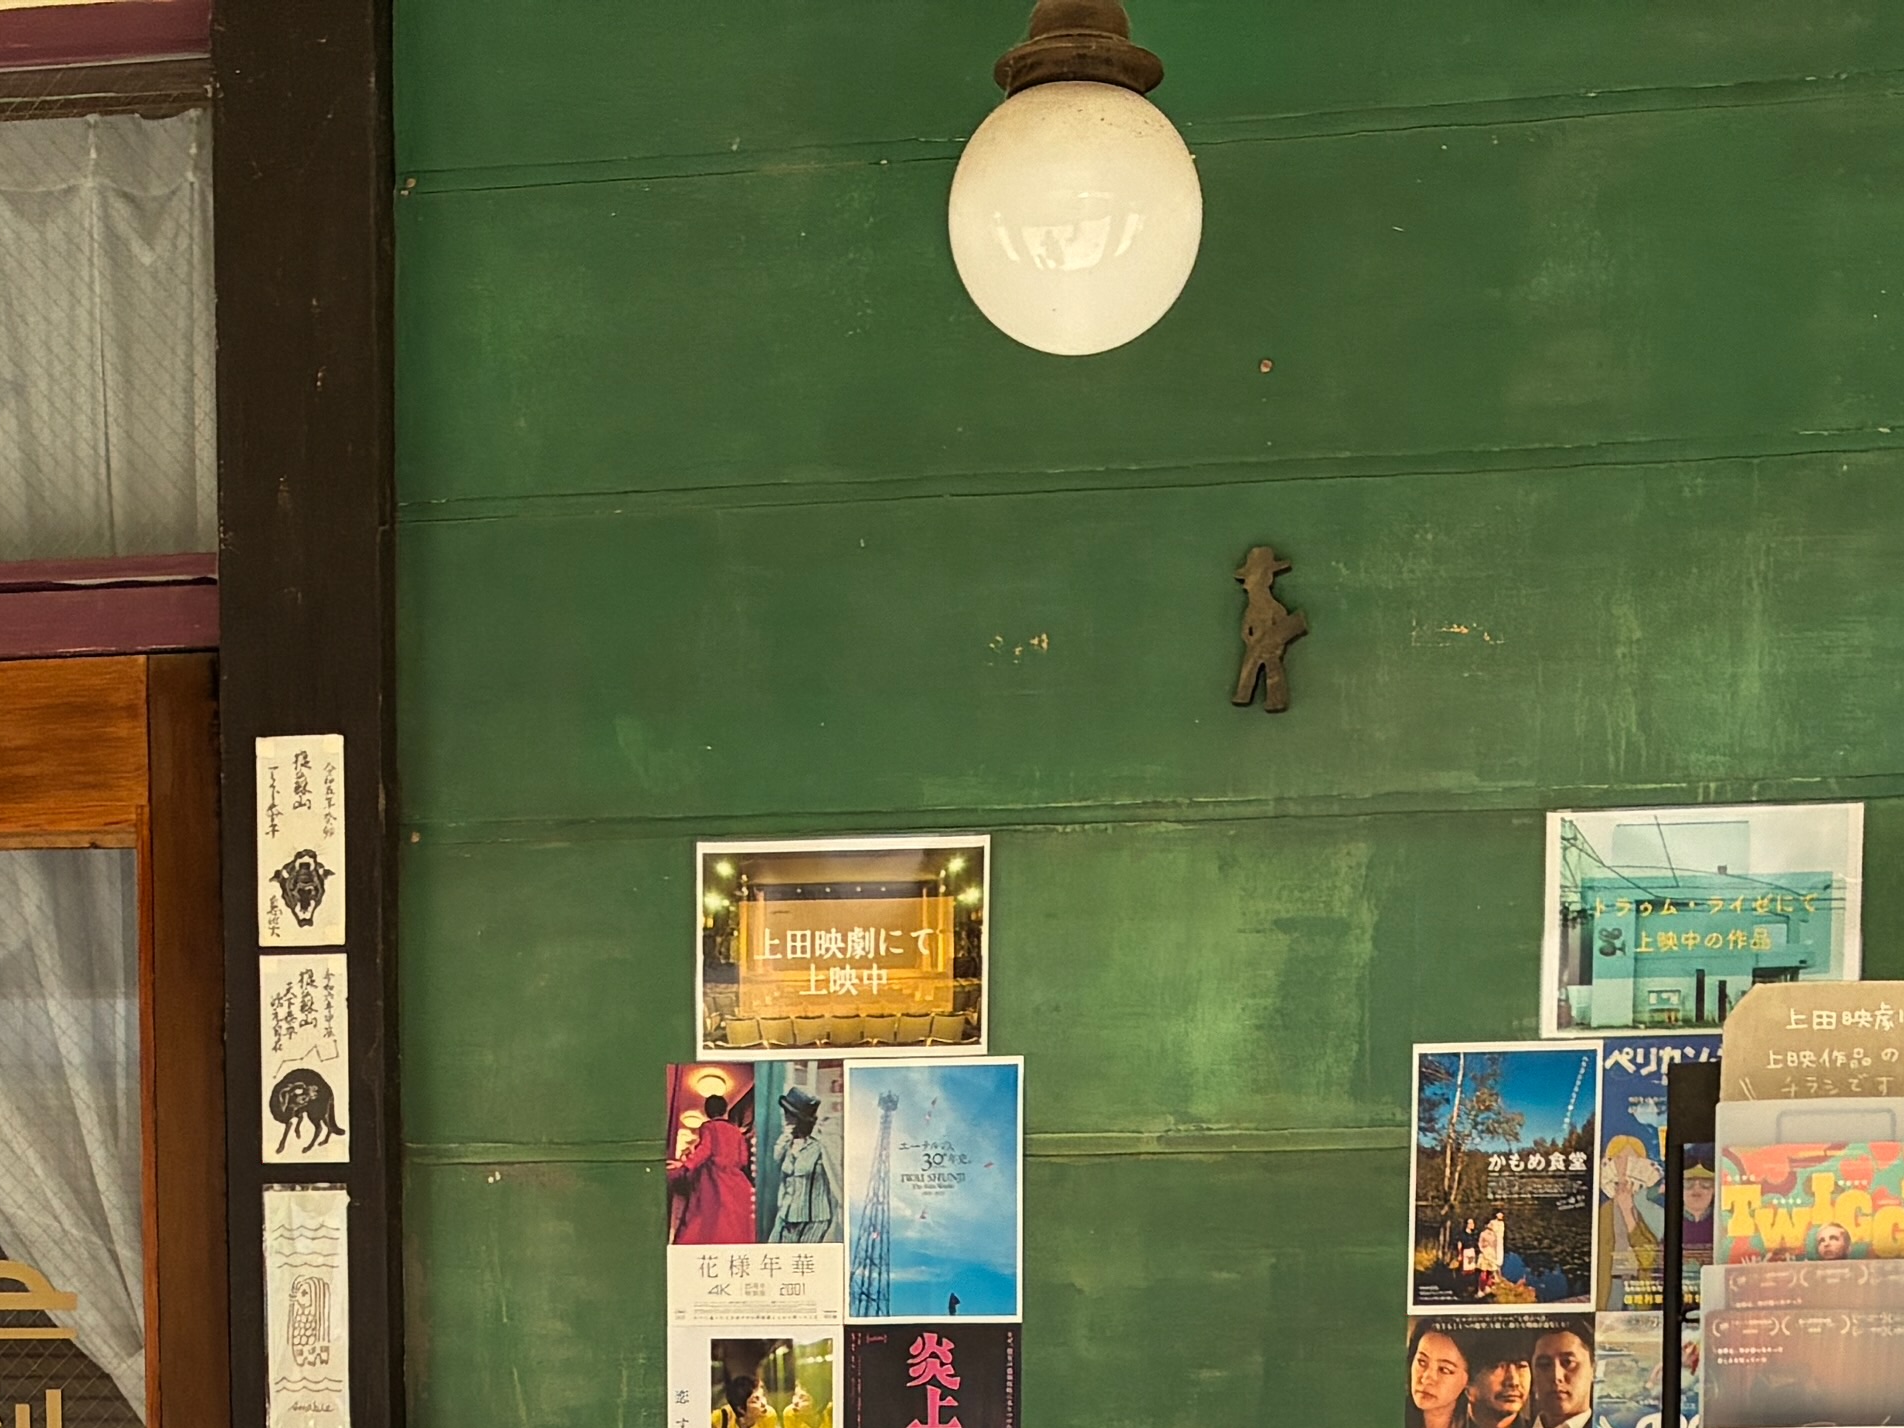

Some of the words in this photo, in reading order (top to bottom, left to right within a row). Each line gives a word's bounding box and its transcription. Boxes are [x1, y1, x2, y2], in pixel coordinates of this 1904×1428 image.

[753, 926, 936, 961] 上田映劇にて
[1634, 928, 1773, 954] 上映中の作品
[798, 963, 889, 997] 上映中
[1765, 1047, 1899, 1069] 上映作品の
[1781, 1073, 1896, 1096] チラシです
[1487, 1151, 1588, 1172] かもめ食堂
[696, 1253, 816, 1279] 花様年華
